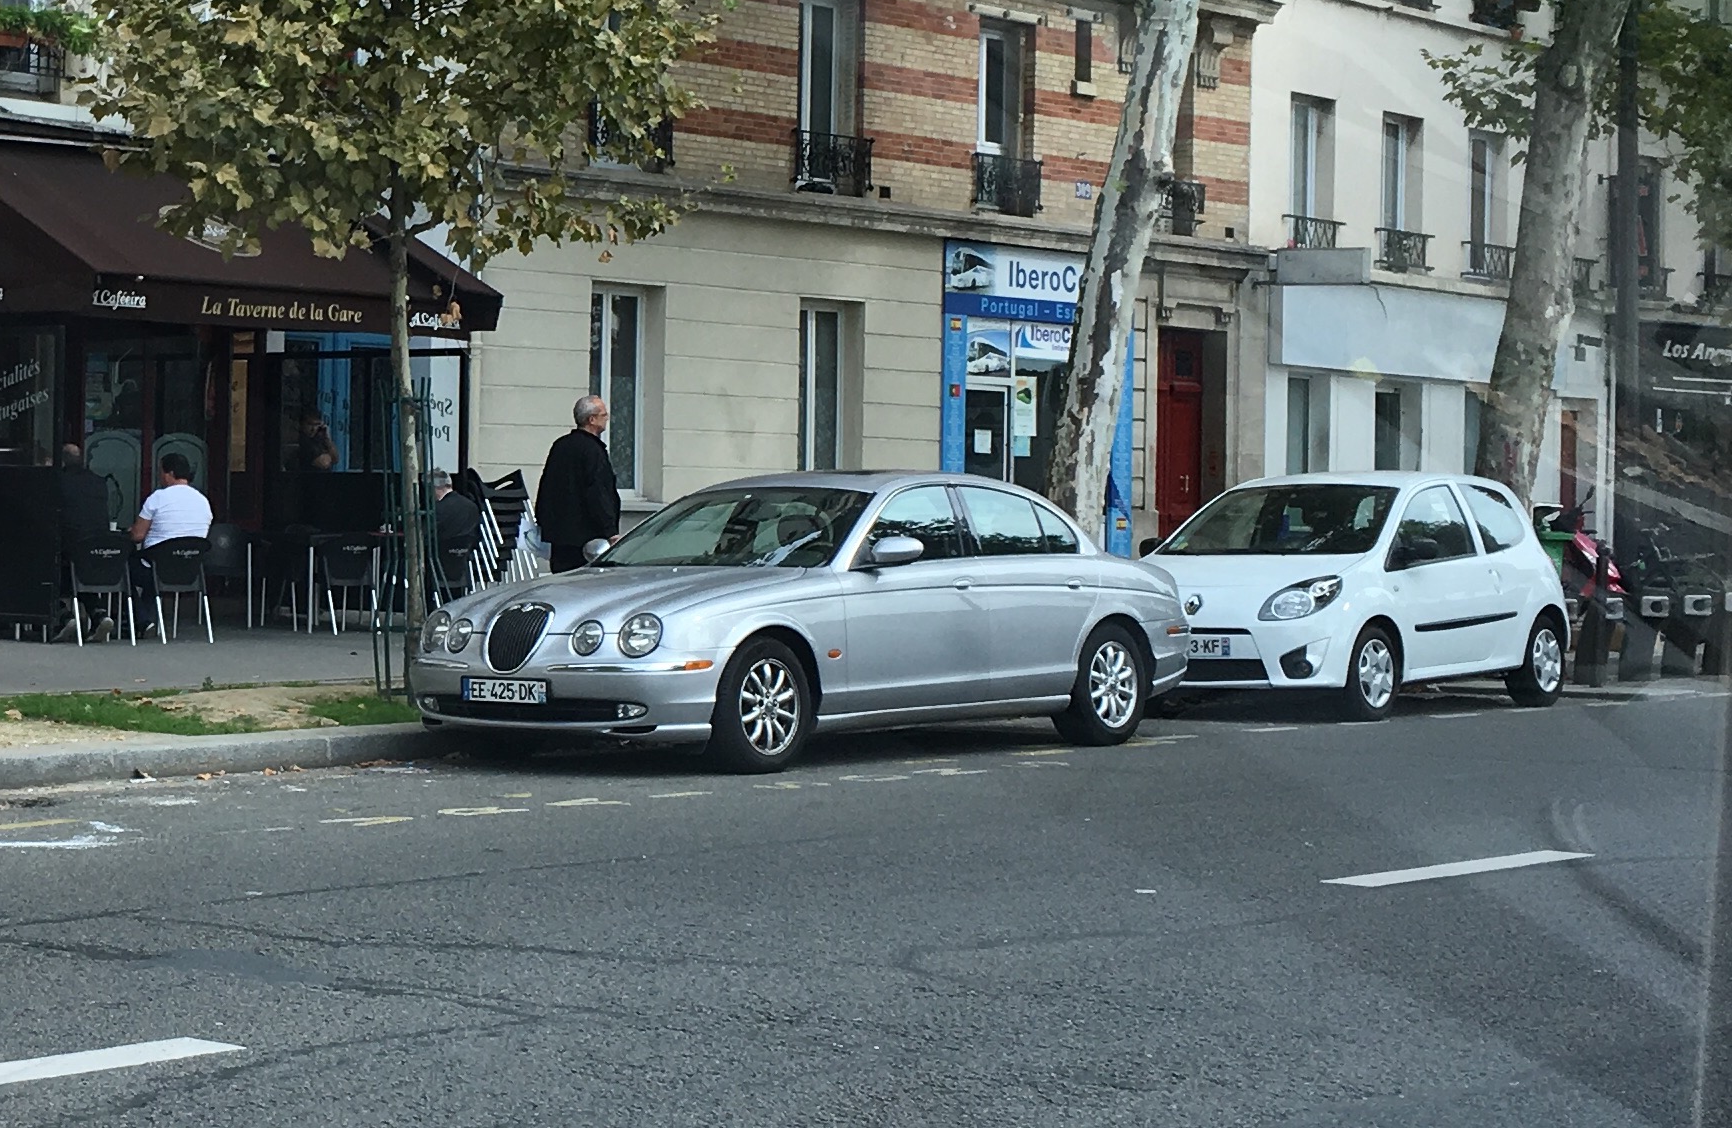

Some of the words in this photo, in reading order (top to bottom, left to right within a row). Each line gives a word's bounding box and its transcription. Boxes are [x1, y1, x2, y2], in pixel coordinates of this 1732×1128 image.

[201, 296, 221, 315] La
[228, 298, 285, 319] Taverne
[289, 302, 306, 320] de
[310, 303, 324, 321] la
[328, 304, 363, 323] Gare
[981, 297, 1038, 319] Portugal
[1662, 340, 1690, 358] Los
